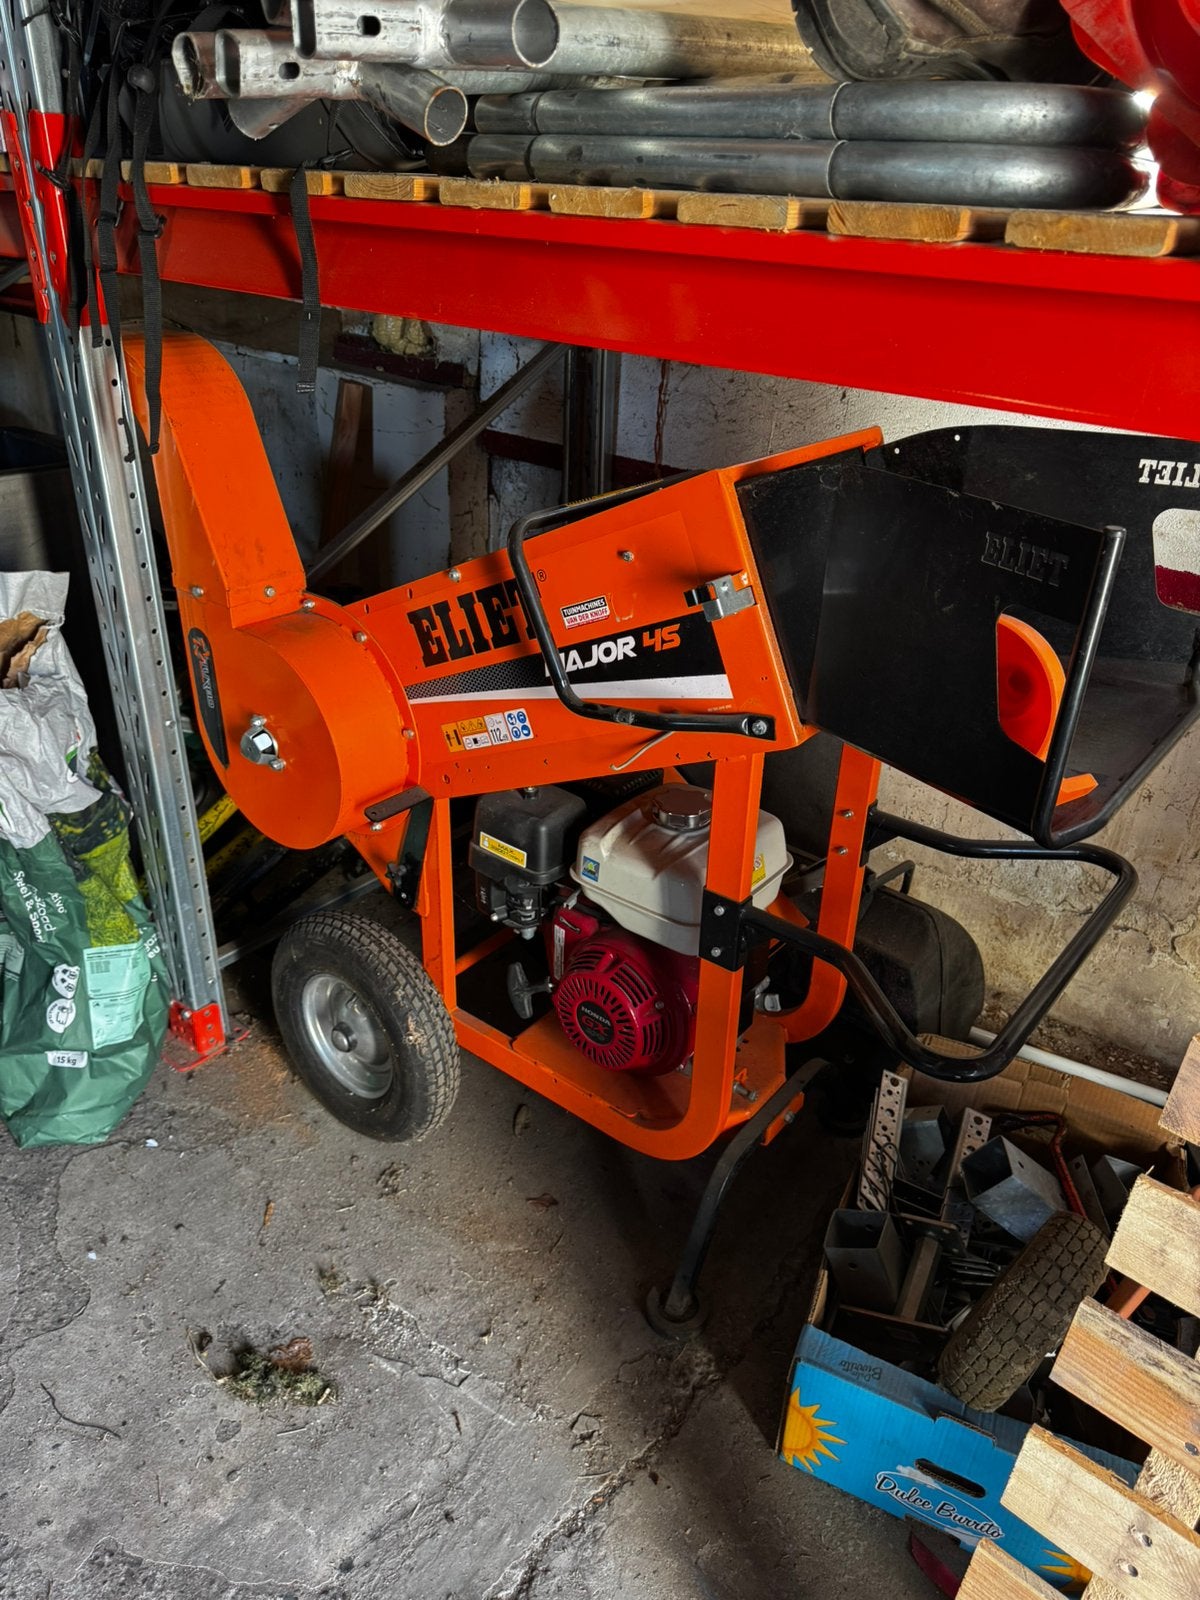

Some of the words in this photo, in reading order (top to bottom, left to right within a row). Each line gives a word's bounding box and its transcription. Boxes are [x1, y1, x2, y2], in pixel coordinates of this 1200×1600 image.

[981, 531, 1069, 587] ELIET
[563, 598, 605, 616] TUINMACHINES
[565, 616, 578, 625] VAN
[577, 612, 590, 622] DER
[490, 727, 504, 743] 112
[581, 1005, 612, 1028] HONDA
[57, 1056, 66, 1064] 15
[67, 1056, 77, 1066] kg
[875, 1473, 933, 1511] Dulce
[934, 1501, 1004, 1540] Burrito
